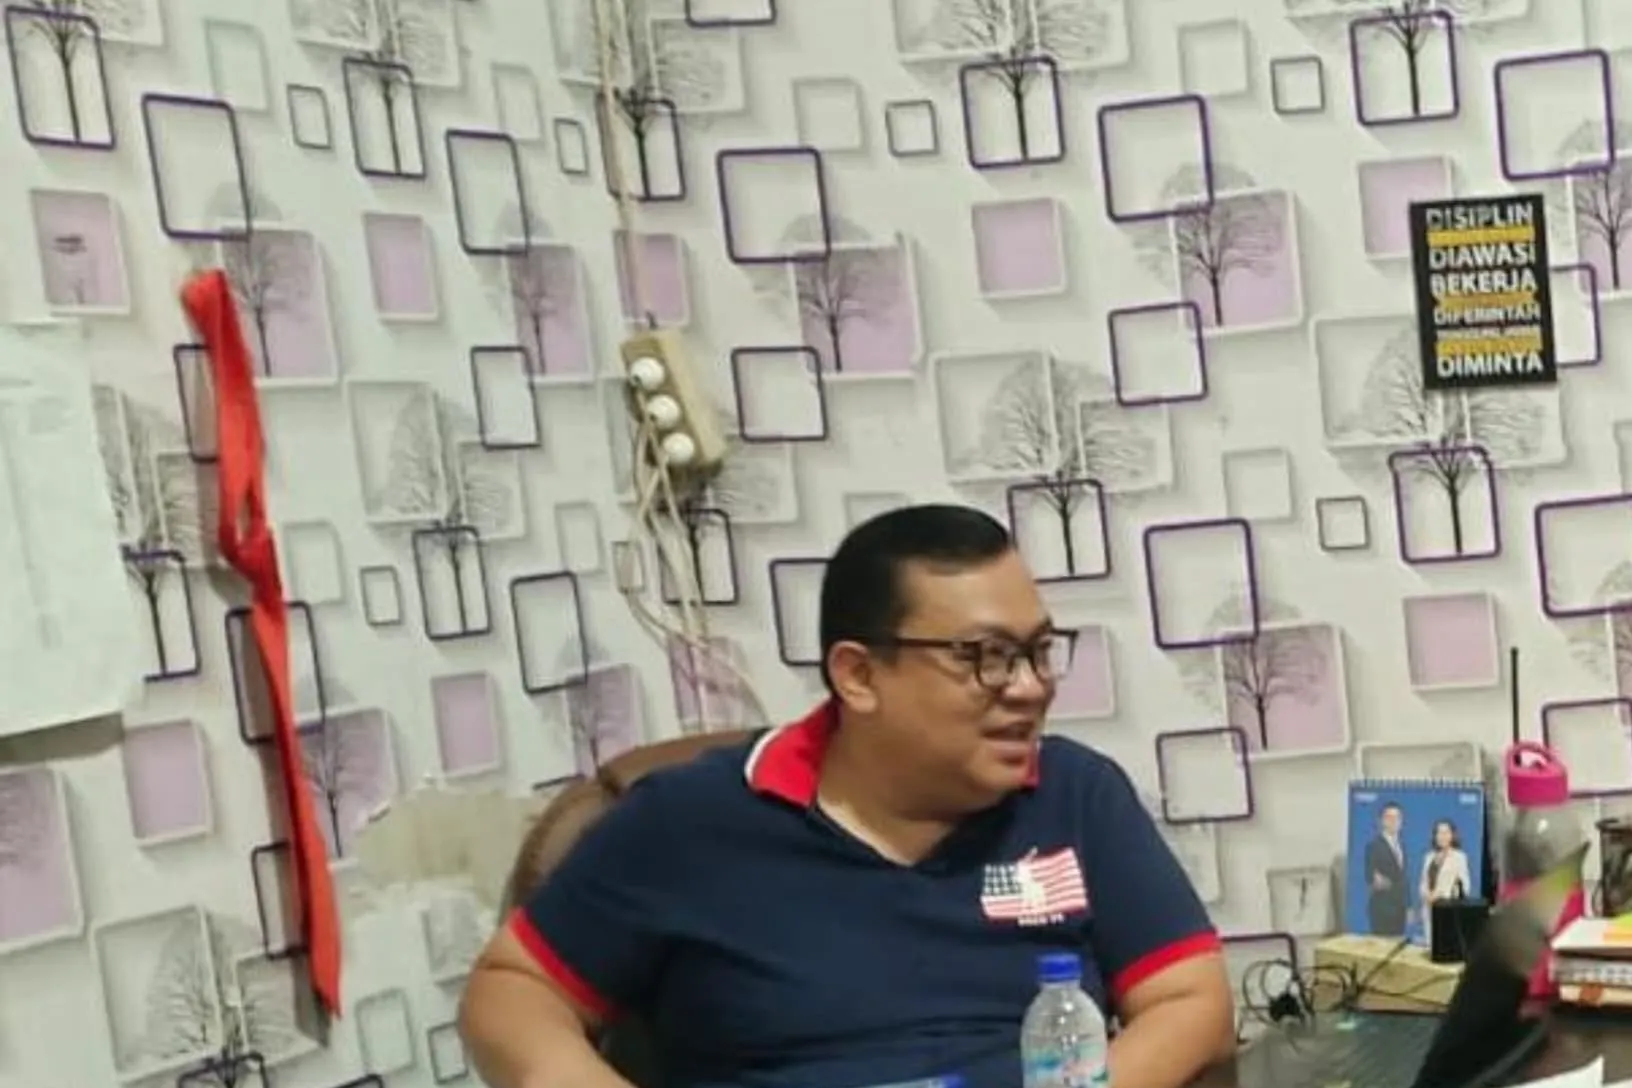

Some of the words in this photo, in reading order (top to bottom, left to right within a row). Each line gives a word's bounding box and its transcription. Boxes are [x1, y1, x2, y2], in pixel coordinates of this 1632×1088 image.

[1425, 203, 1534, 229] DISIPLIN
[1429, 242, 1536, 269] DIAWASI
[1430, 268, 1538, 297] BEKERJA
[1437, 351, 1544, 377] DIMINTA
